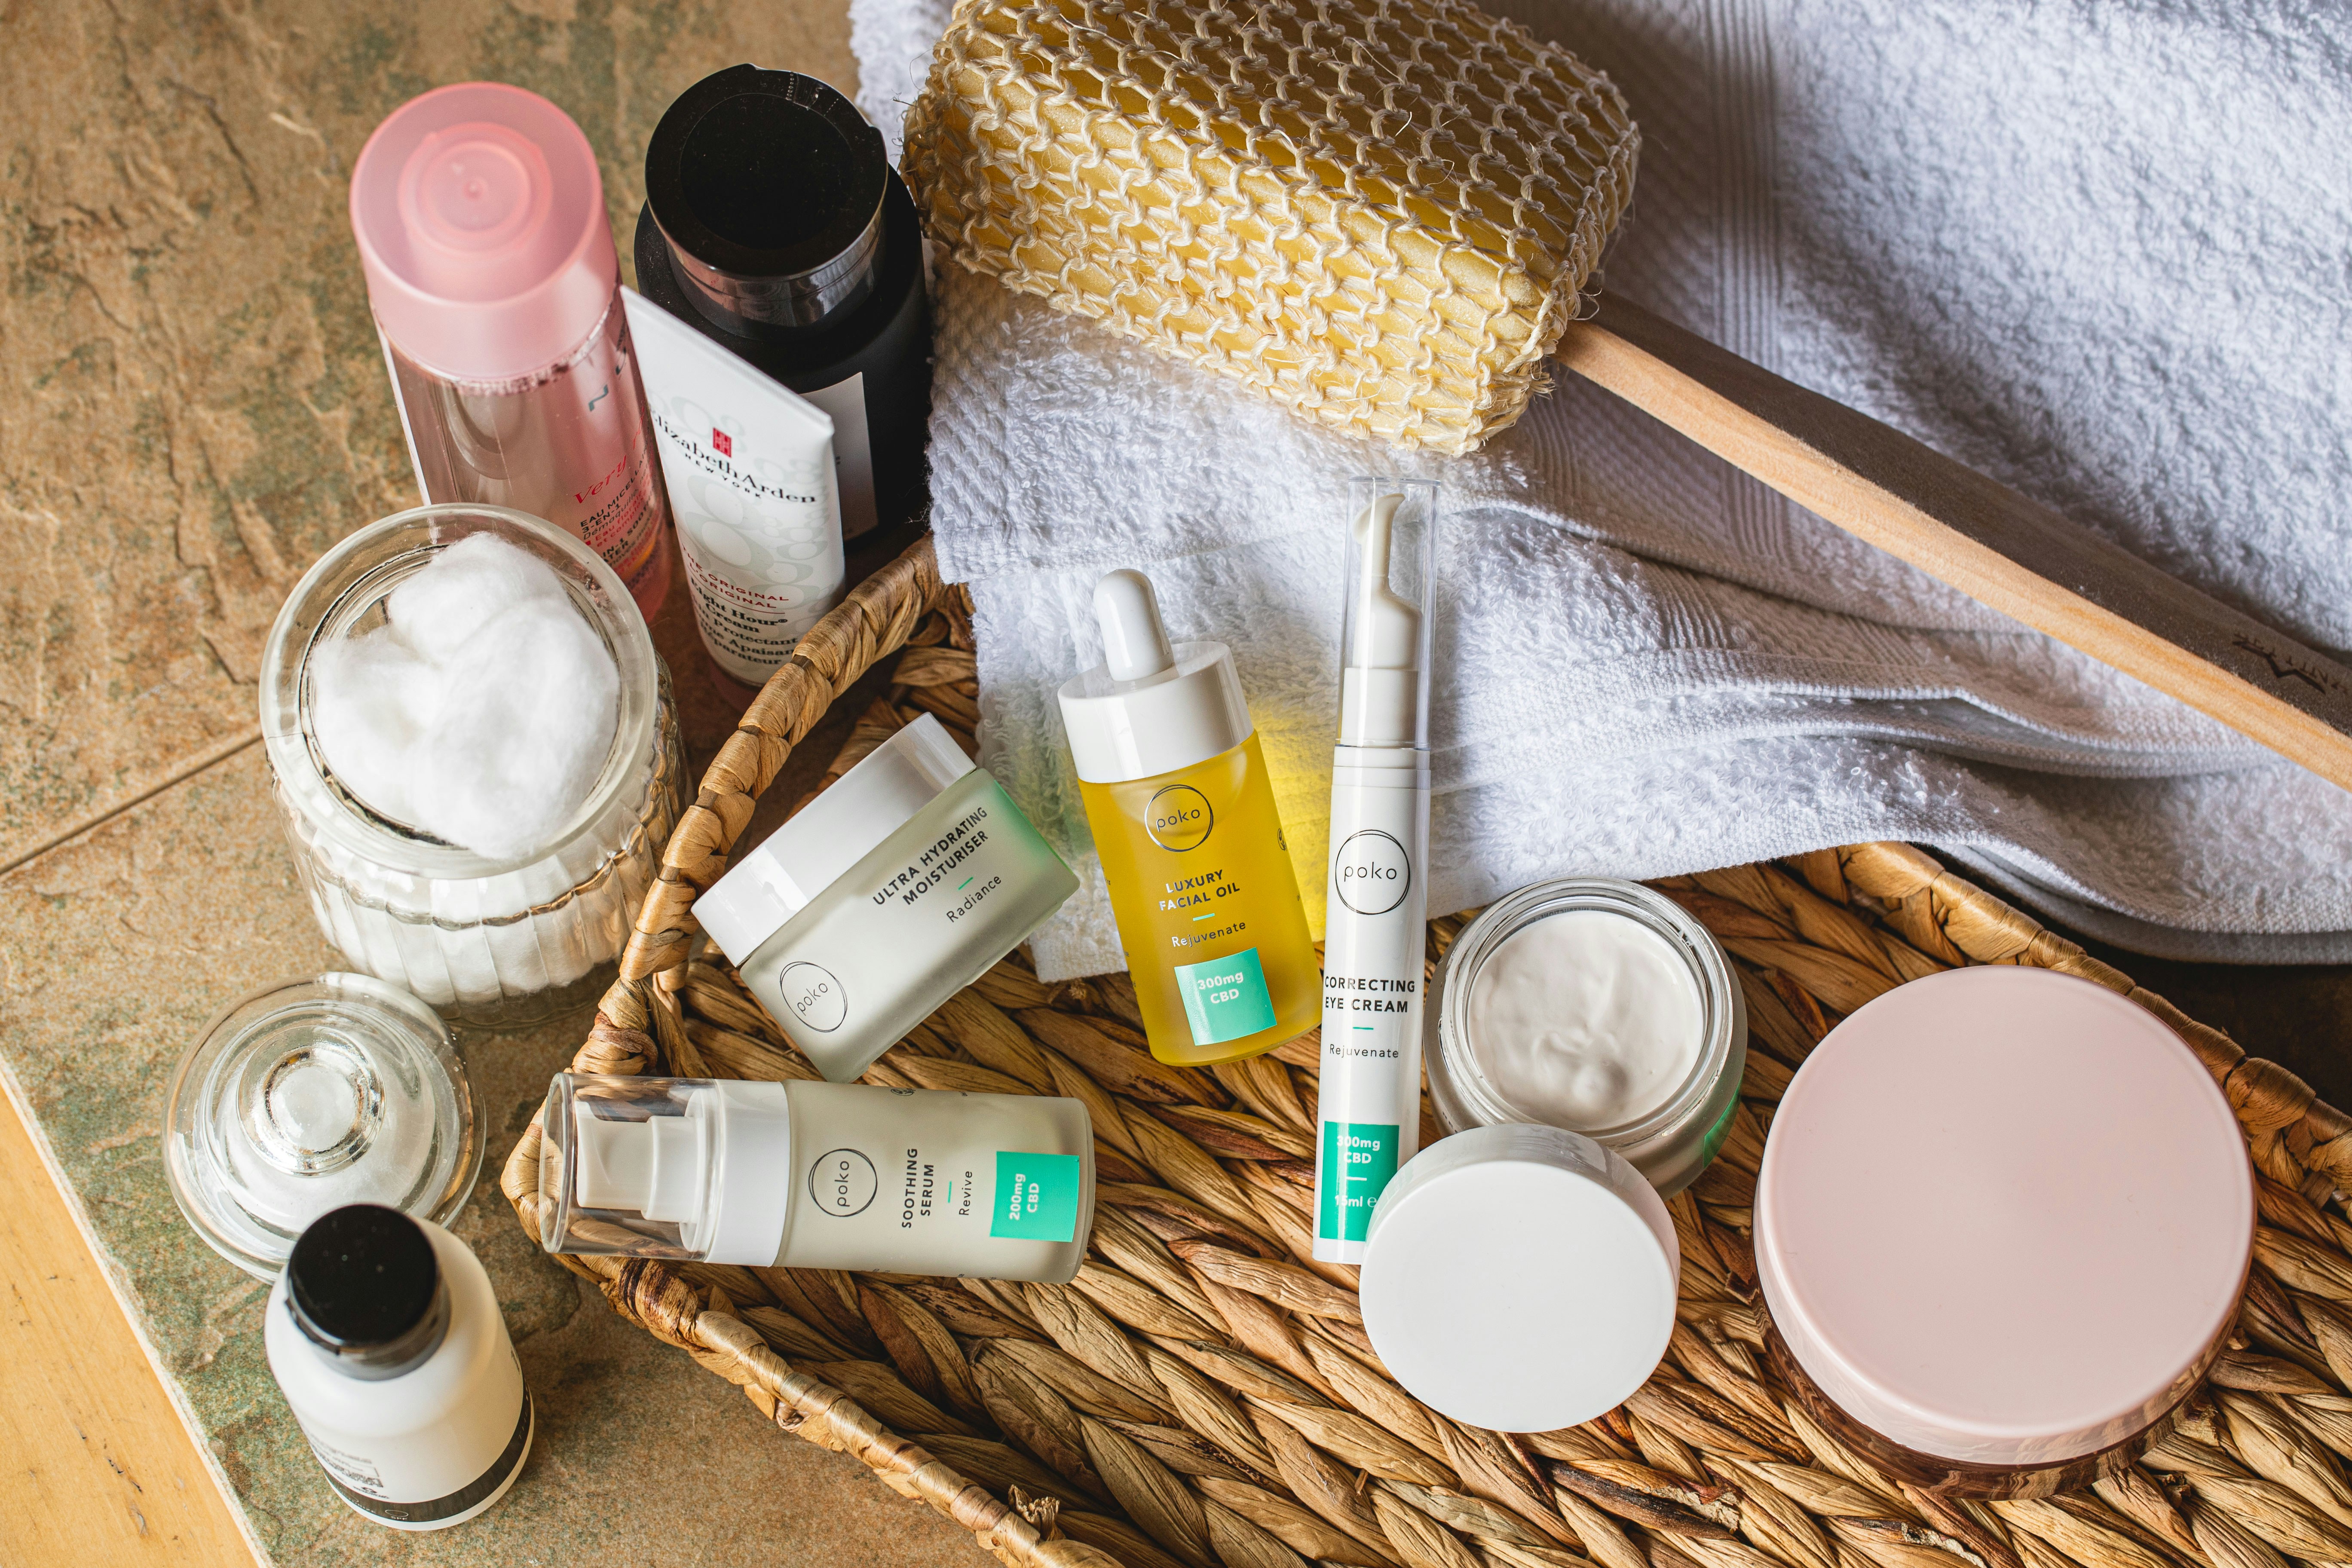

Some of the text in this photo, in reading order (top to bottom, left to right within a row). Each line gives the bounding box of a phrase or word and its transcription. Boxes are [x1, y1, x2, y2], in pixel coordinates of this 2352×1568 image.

[573, 454, 627, 504] Very
[685, 453, 762, 499] NEW YORK
[580, 508, 604, 527] EAU
[582, 503, 621, 533] 3-EN-1
[595, 526, 615, 541] Eau
[597, 537, 608, 547] et
[690, 562, 777, 608] L'ORIGINAL
[691, 576, 727, 612] Eight
[708, 573, 789, 601] ORIGINAL
[705, 603, 760, 633] Cream
[713, 618, 798, 645] Protectant
[701, 622, 782, 665] parateur
[730, 639, 794, 656] Apaisan
[1156, 809, 1200, 832] poko
[873, 807, 987, 905] ULTRA HYDRATING
[902, 830, 989, 905] MOISTURISER
[1166, 870, 1223, 894] LUXURY
[1344, 861, 1397, 882] poko
[946, 876, 1001, 922] Radiance
[1159, 883, 1240, 911] FACIAL OIL
[1172, 922, 1246, 947] Rejuvenate
[1197, 972, 1243, 989] 300mg
[1325, 976, 1415, 992] CORRECTING
[797, 983, 828, 1016] poko
[1210, 989, 1239, 1004] CBD
[1326, 997, 1408, 1013] EYE CREAM
[1330, 1044, 1399, 1058] Rejuvenate
[1337, 1135, 1380, 1152] 300mg
[1343, 1152, 1372, 1164] CBD
[835, 1161, 850, 1207] poko
[902, 1148, 918, 1228] SOOTHING
[921, 1165, 934, 1216] SERUM
[959, 1171, 973, 1216] Revive
[1009, 1174, 1026, 1220] 200mg
[1027, 1183, 1039, 1213] CBD
[1335, 1194, 1363, 1207] 15ml
